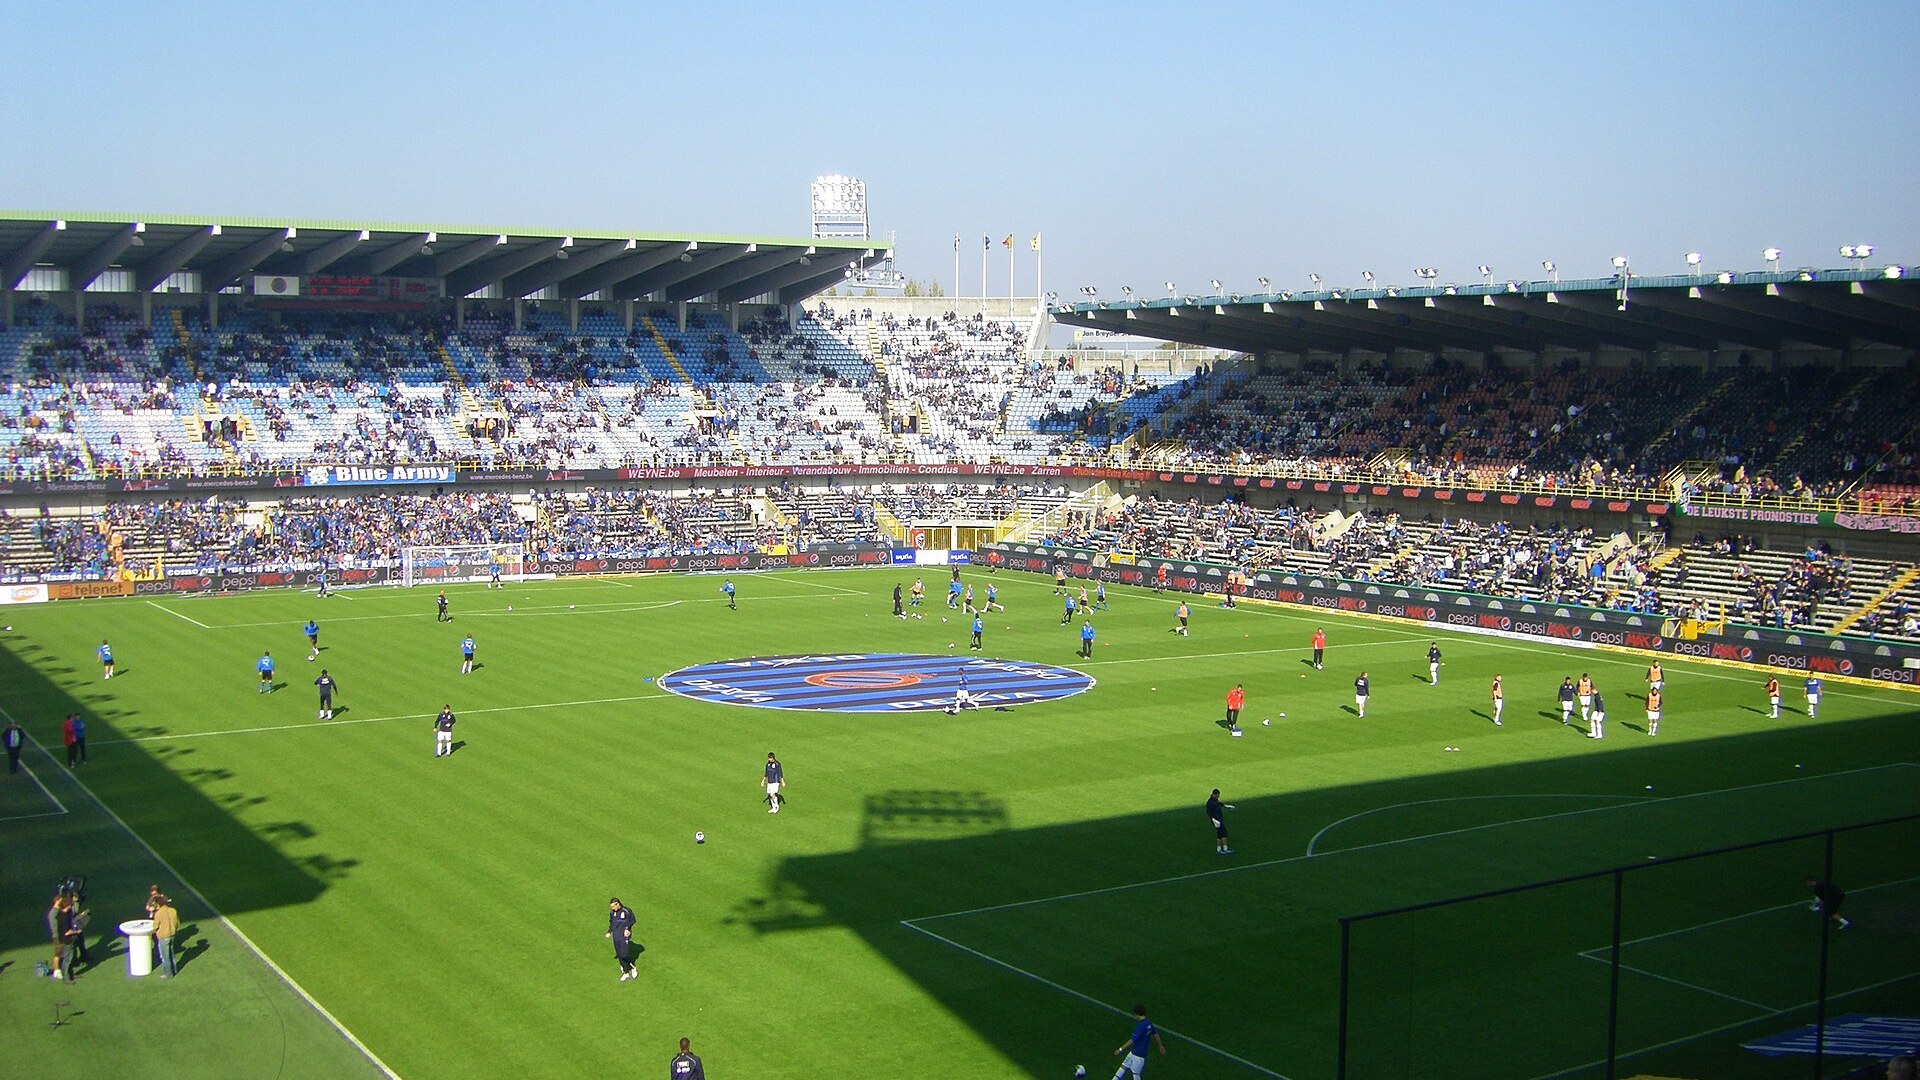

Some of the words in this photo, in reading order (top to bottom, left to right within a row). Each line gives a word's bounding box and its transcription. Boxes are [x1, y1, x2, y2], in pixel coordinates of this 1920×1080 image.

[336, 466, 389, 481] Blue
[393, 466, 449, 481] Army
[469, 473, 534, 482] www.mercedes-benz.be
[628, 469, 680, 479] WEYNE.be
[694, 468, 738, 478] Meubelen
[746, 467, 785, 477] Interieur
[793, 466, 851, 476] Verandabouw
[858, 465, 913, 475] Immobilien
[918, 465, 959, 475] Condius
[974, 465, 1025, 475] WEYNE.be
[1031, 466, 1061, 476] Zarren
[1686, 505, 1700, 517] DE
[1702, 506, 1749, 520] LEUKSTE
[1750, 509, 1819, 525] PRONOSTIEK
[616, 559, 646, 571] pepsi
[688, 556, 717, 569] pepsi
[759, 554, 788, 567] pepsi
[830, 552, 858, 565] pepsi
[1009, 558, 1027, 570] pepsi
[543, 563, 574, 576] pepsi
[1100, 569, 1120, 583] pepsi
[136, 582, 172, 595] pepsi
[222, 576, 257, 589] pepsi
[1199, 580, 1222, 594] pepsi
[75, 583, 123, 597] telenet
[1253, 587, 1277, 601] pepsi
[1312, 595, 1338, 609] pepsi
[1377, 604, 1404, 617] pepsi
[1447, 613, 1476, 627] pepsi
[1515, 621, 1546, 635] pepsi
[1590, 630, 1624, 646] pepsi
[1674, 642, 1711, 657] pepsi
[1768, 653, 1807, 670] pepsi
[1870, 666, 1914, 684] pepsi
